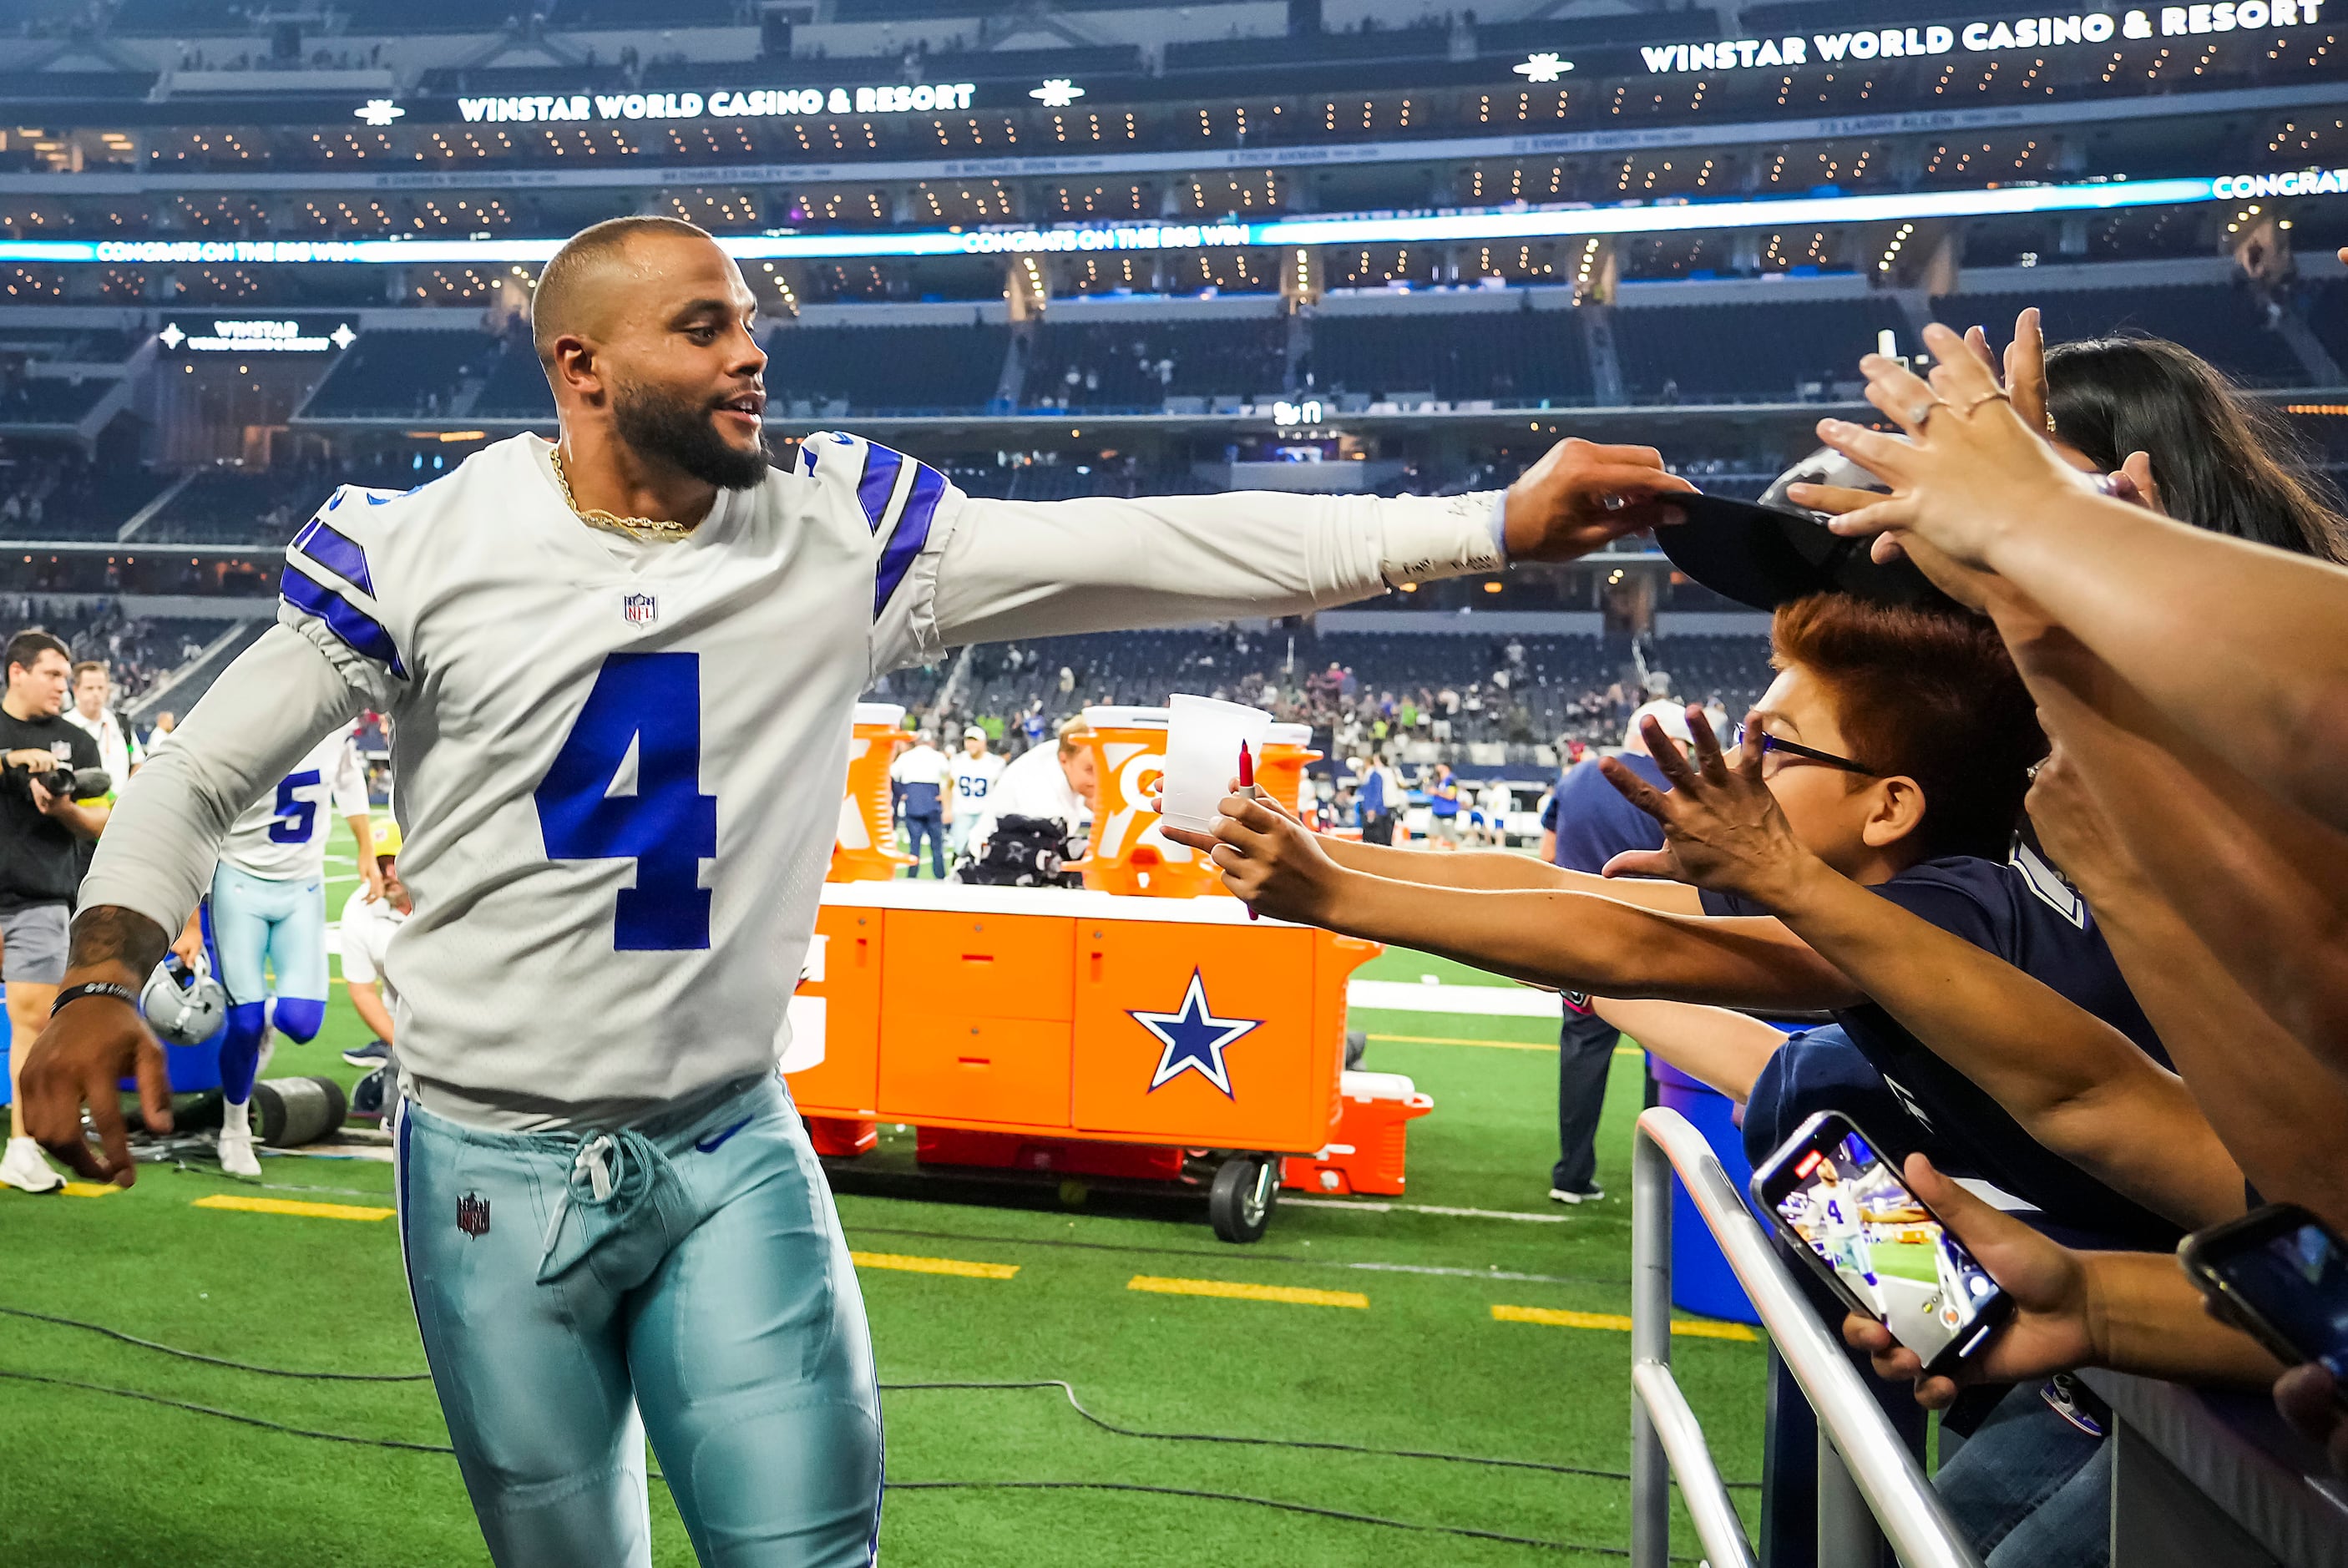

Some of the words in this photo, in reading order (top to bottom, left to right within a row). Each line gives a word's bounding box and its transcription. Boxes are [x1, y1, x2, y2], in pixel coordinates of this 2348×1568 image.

[1640, 37, 1807, 73] WINSTAR
[1813, 25, 1954, 62] WORLD
[1961, 13, 2114, 53] CASINO
[2122, 9, 2153, 40] &
[2161, 0, 2325, 37] RESORT
[458, 95, 591, 123] WINSTAR
[595, 93, 704, 120] WORLD
[708, 88, 824, 117] CASINO
[827, 88, 852, 114] &
[856, 83, 975, 113] RESORT
[96, 240, 201, 262] CONGRATS
[201, 241, 235, 261] ON
[235, 241, 276, 262] THE
[962, 230, 1077, 254] CONGRATS
[1077, 229, 1115, 250] ON
[1115, 227, 1160, 250] THE
[1161, 225, 1202, 248] BIG
[1201, 224, 1250, 246] WIN
[214, 321, 300, 338] WINSTAR
[534, 652, 717, 950] 4
[959, 776, 987, 797] 63
[269, 769, 321, 843] 5
[1827, 1200, 1844, 1224] 4
